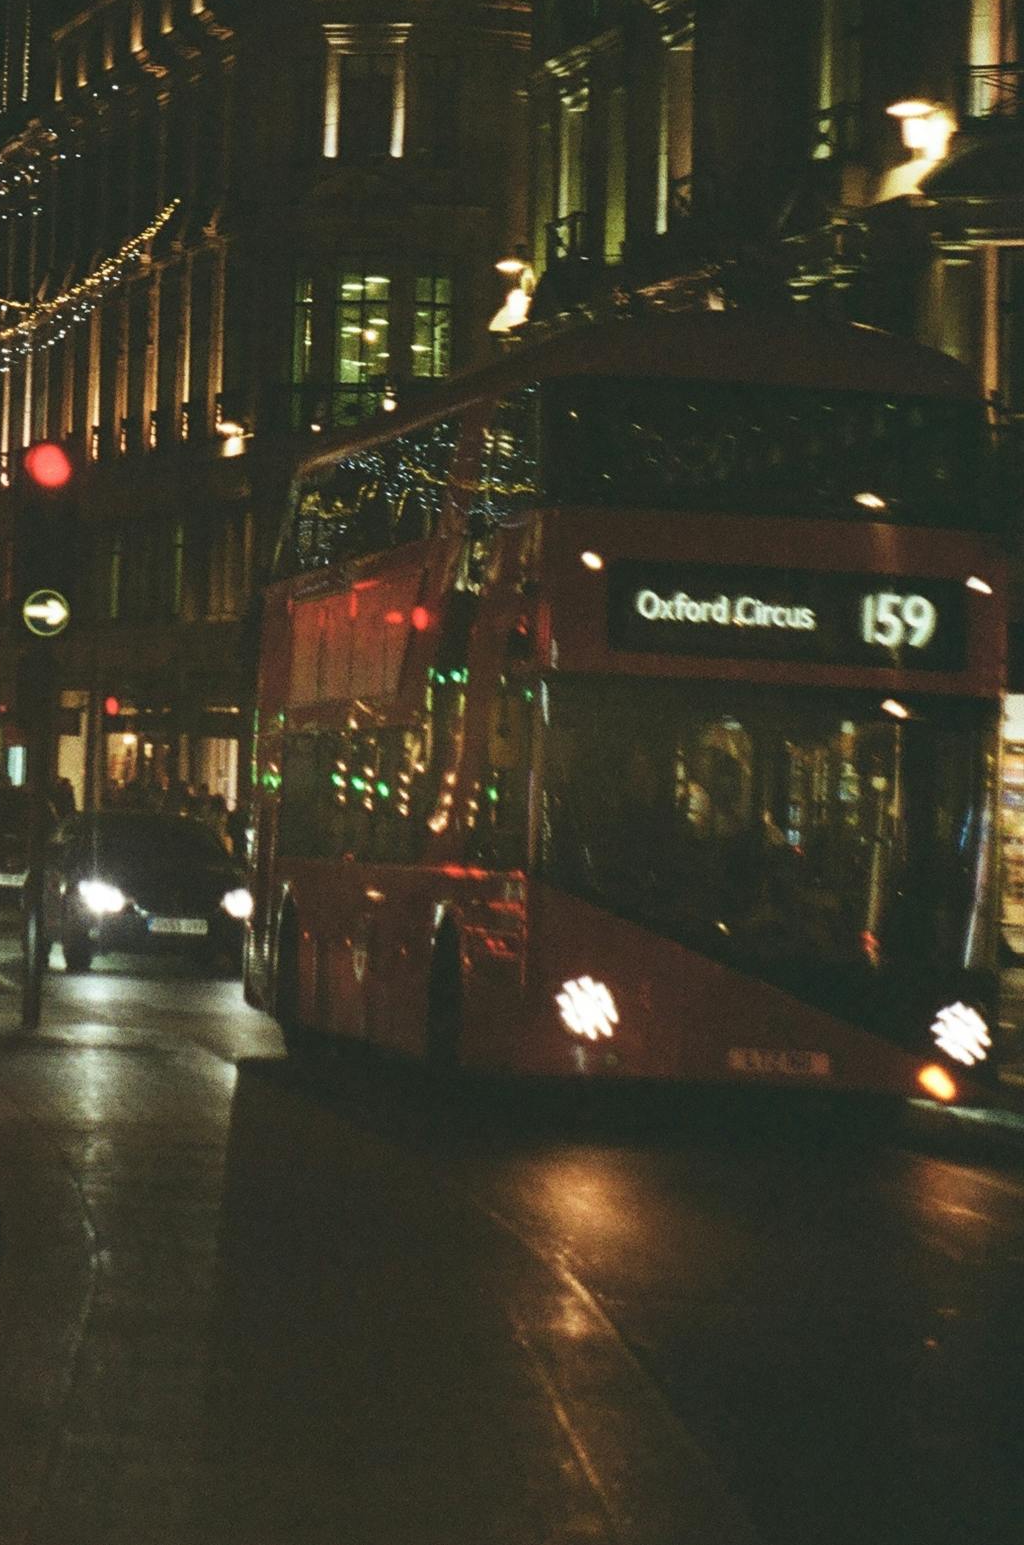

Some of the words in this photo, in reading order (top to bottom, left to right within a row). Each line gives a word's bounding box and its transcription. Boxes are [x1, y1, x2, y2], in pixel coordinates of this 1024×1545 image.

[636, 589, 730, 625] Oxford
[735, 596, 816, 630] Circus
[862, 592, 936, 648] 159
